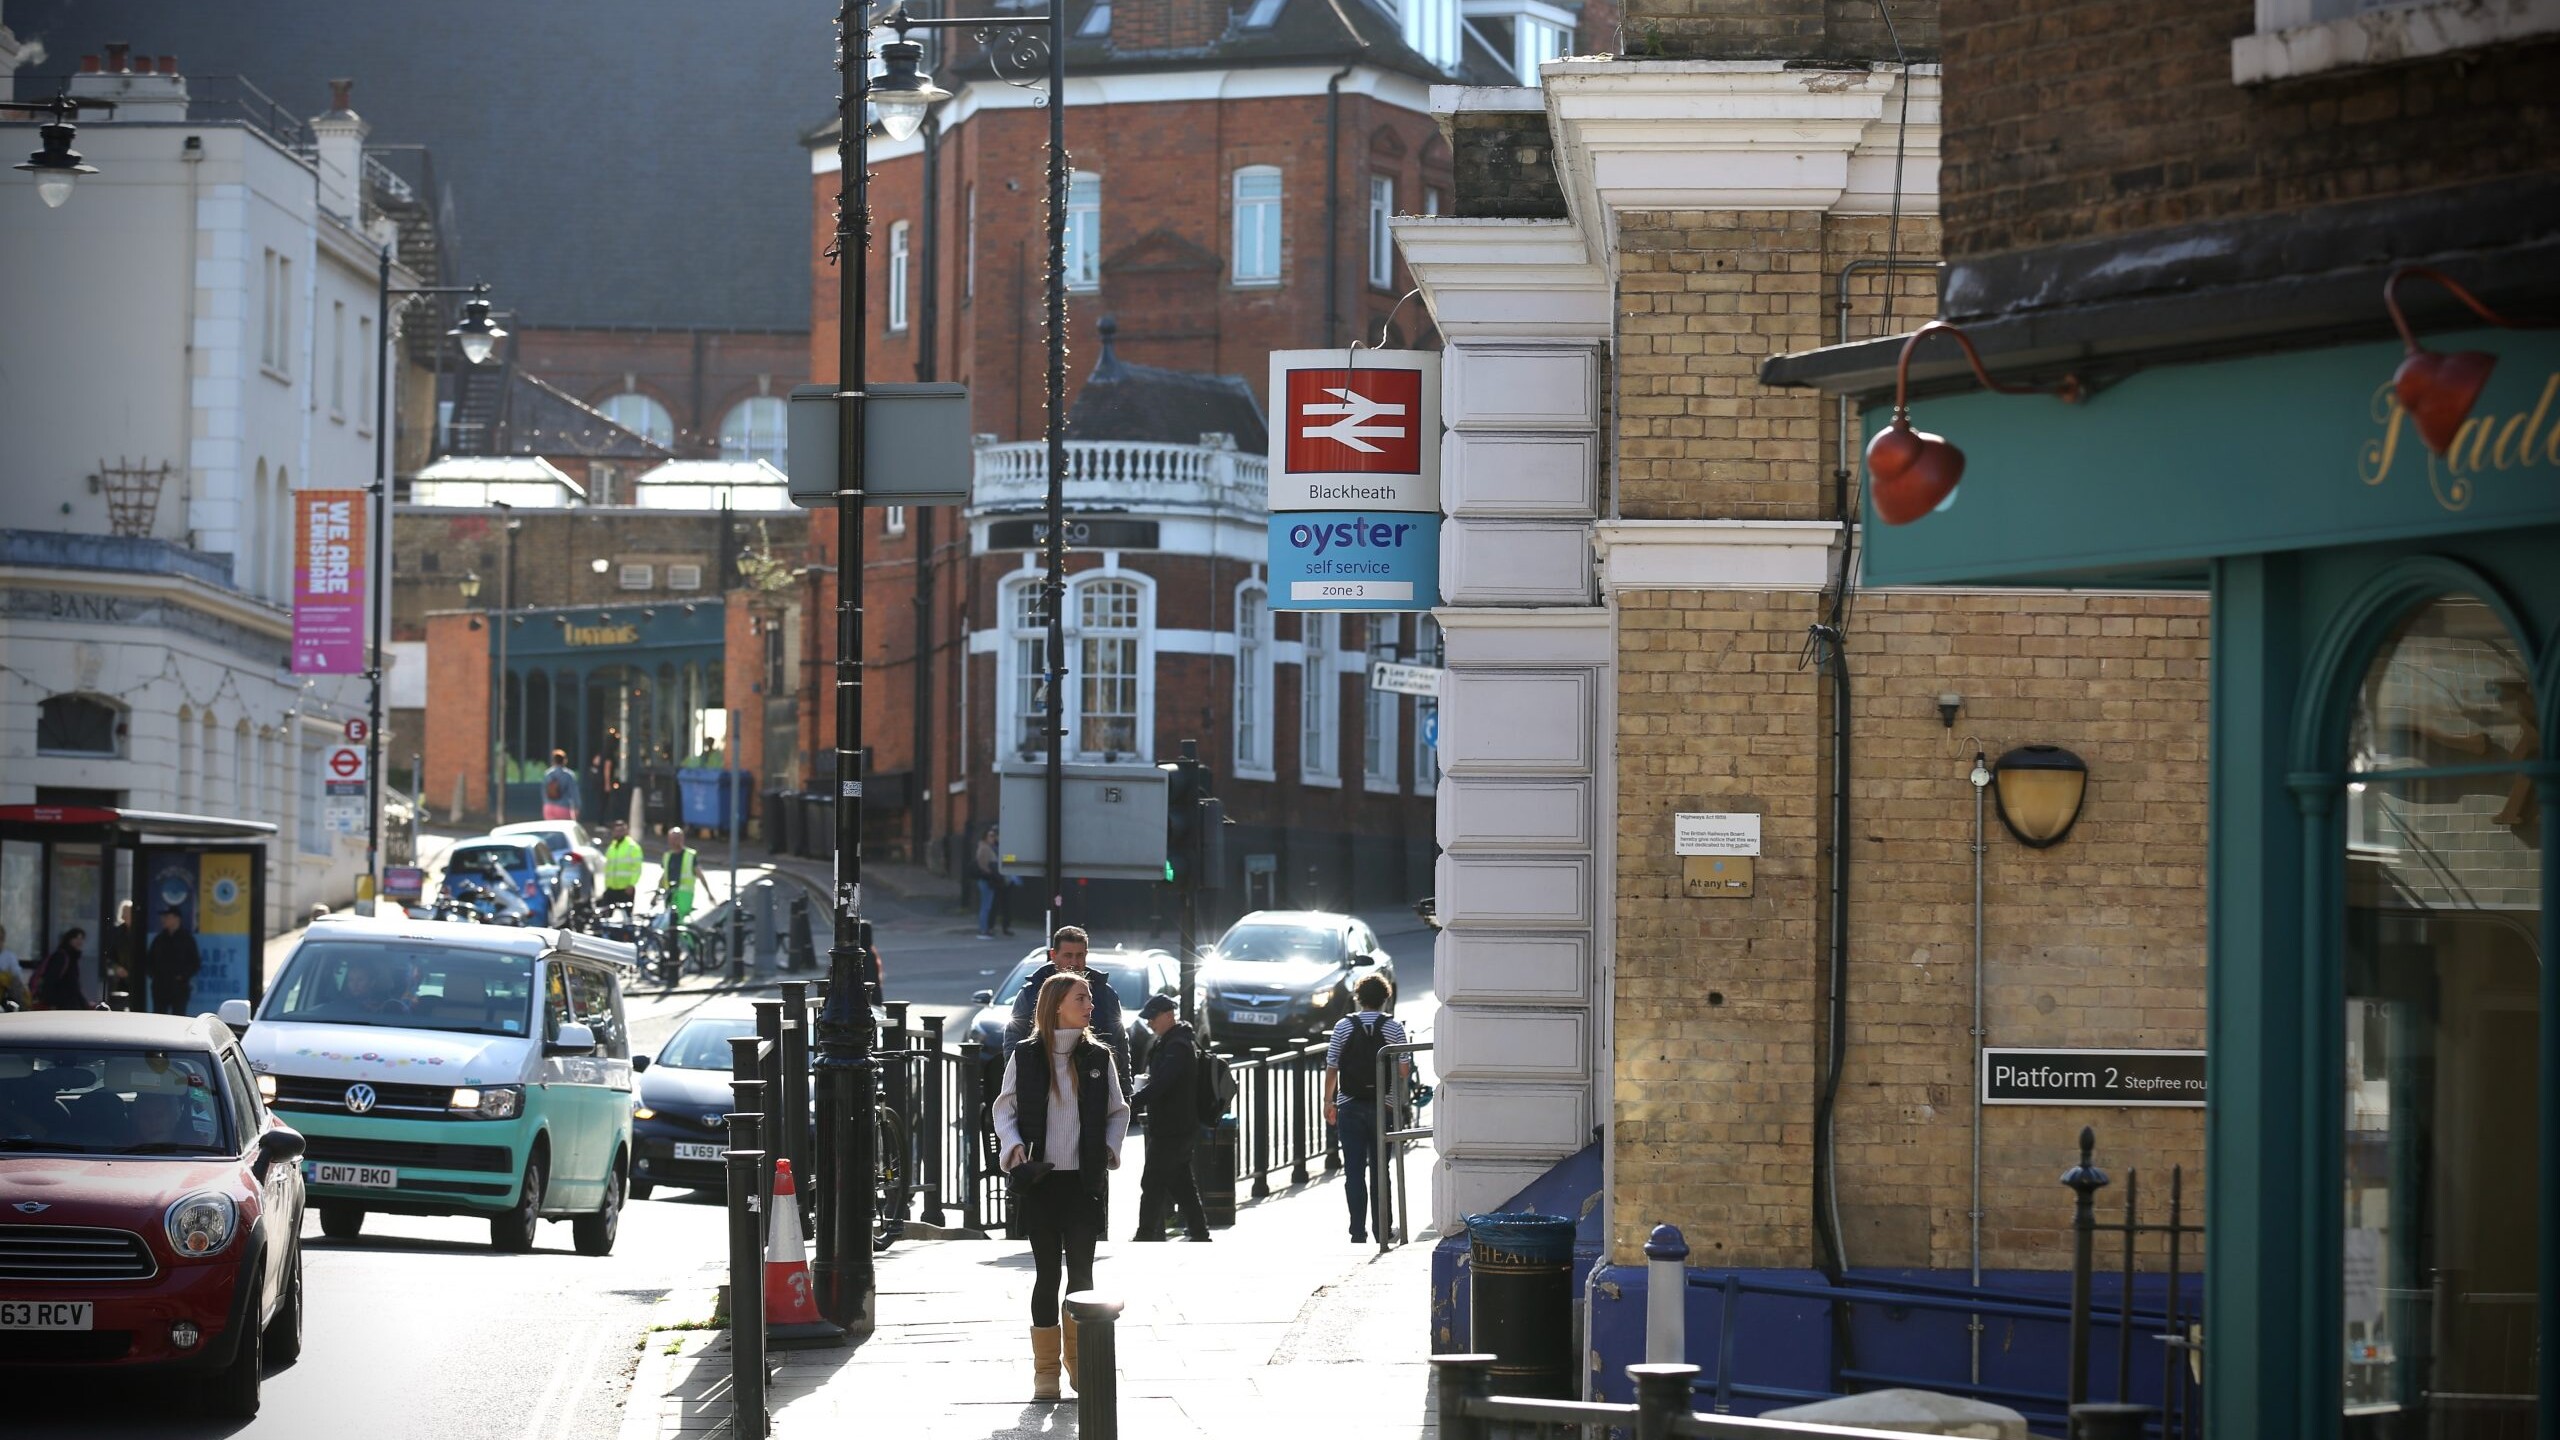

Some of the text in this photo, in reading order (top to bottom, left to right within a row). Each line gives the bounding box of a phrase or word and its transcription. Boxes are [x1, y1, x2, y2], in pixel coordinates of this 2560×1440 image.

[1309, 484, 1396, 500] Blackheath
[1290, 516, 1410, 556] oyster
[309, 501, 328, 594] LEWISHAM
[327, 501, 350, 594] WE ARE
[1306, 559, 1390, 574] self service
[1322, 585, 1364, 596] zone 3
[51, 591, 121, 621] BANK
[350, 722, 362, 739] E
[1690, 879, 1702, 888] At
[1704, 881, 1721, 889] any
[1995, 1066, 2096, 1088] Platform
[2104, 1067, 2118, 1088] 2
[2124, 1076, 2181, 1091] Stepfree
[682, 1145, 714, 1158] LV69
[321, 1166, 354, 1183] GN17
[1, 1304, 84, 1326] 63 RCV
